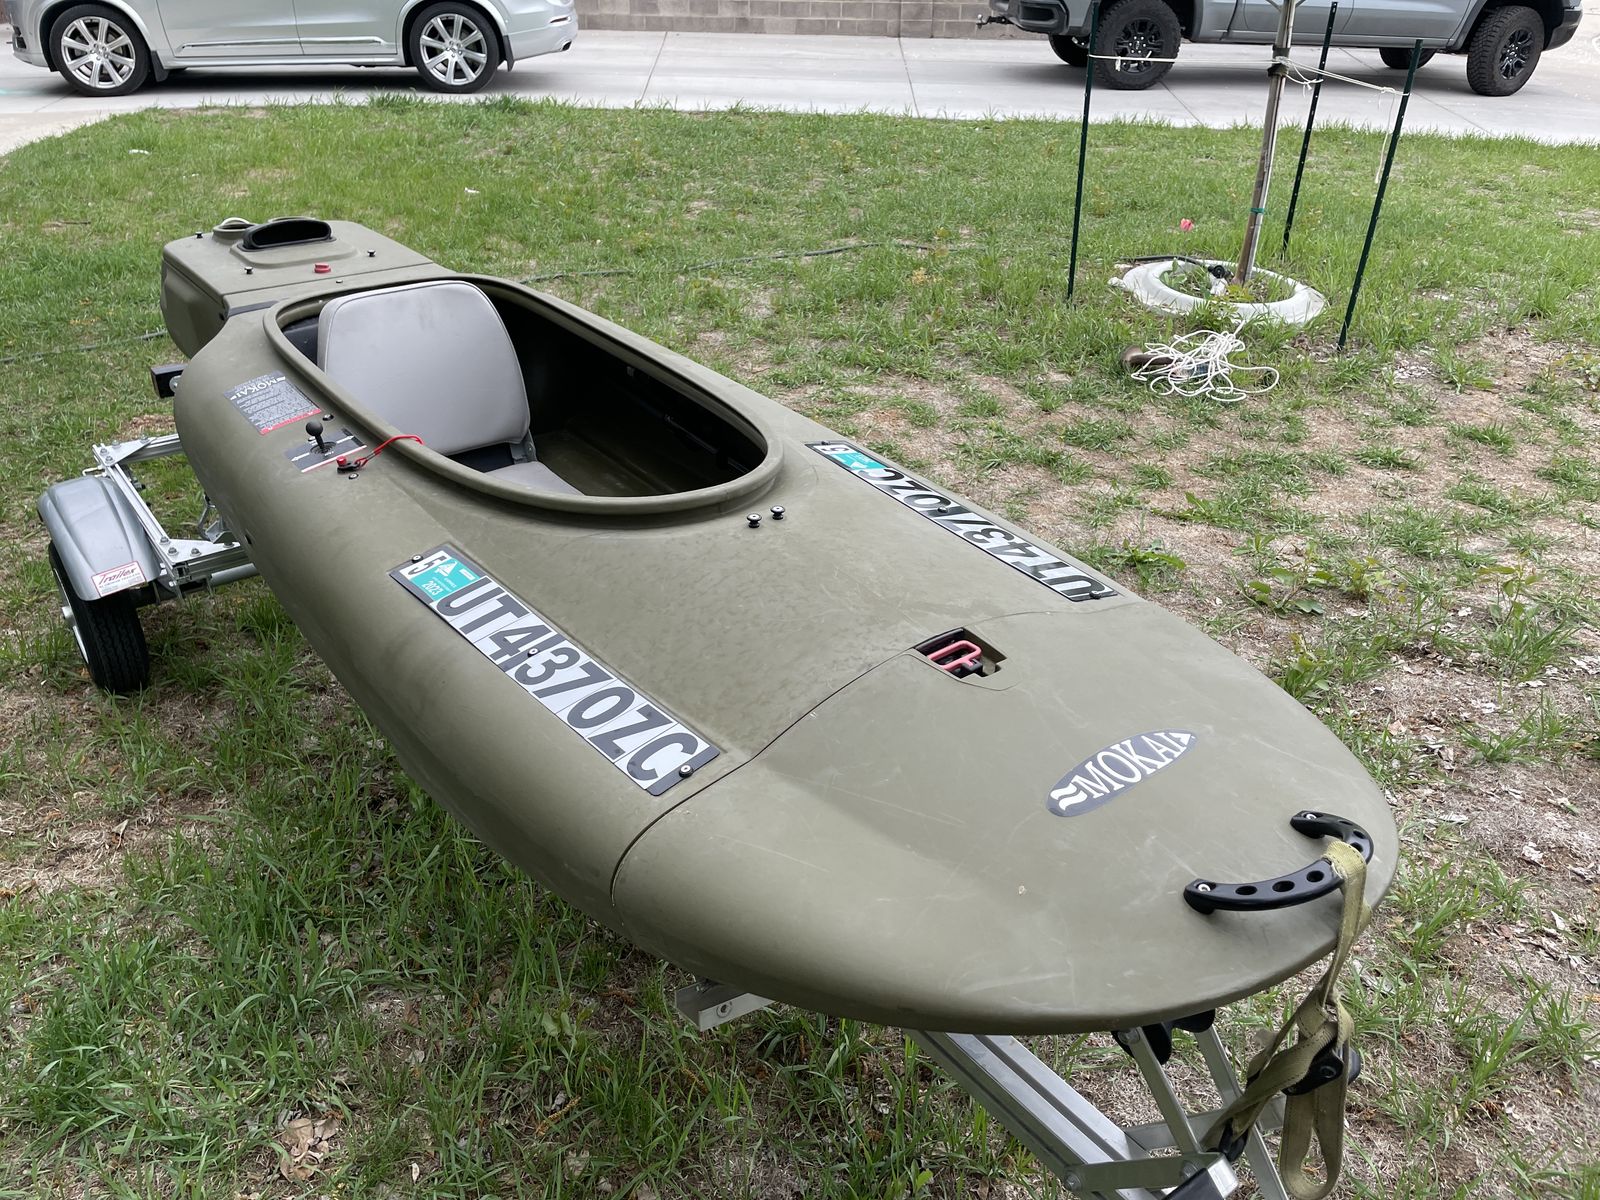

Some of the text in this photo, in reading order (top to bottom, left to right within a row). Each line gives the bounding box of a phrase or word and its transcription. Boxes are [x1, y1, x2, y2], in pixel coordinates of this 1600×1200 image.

[236, 378, 277, 398] MOKAI
[408, 555, 447, 575] 5
[422, 580, 444, 595] 2023
[1071, 731, 1188, 799] MOKAI
